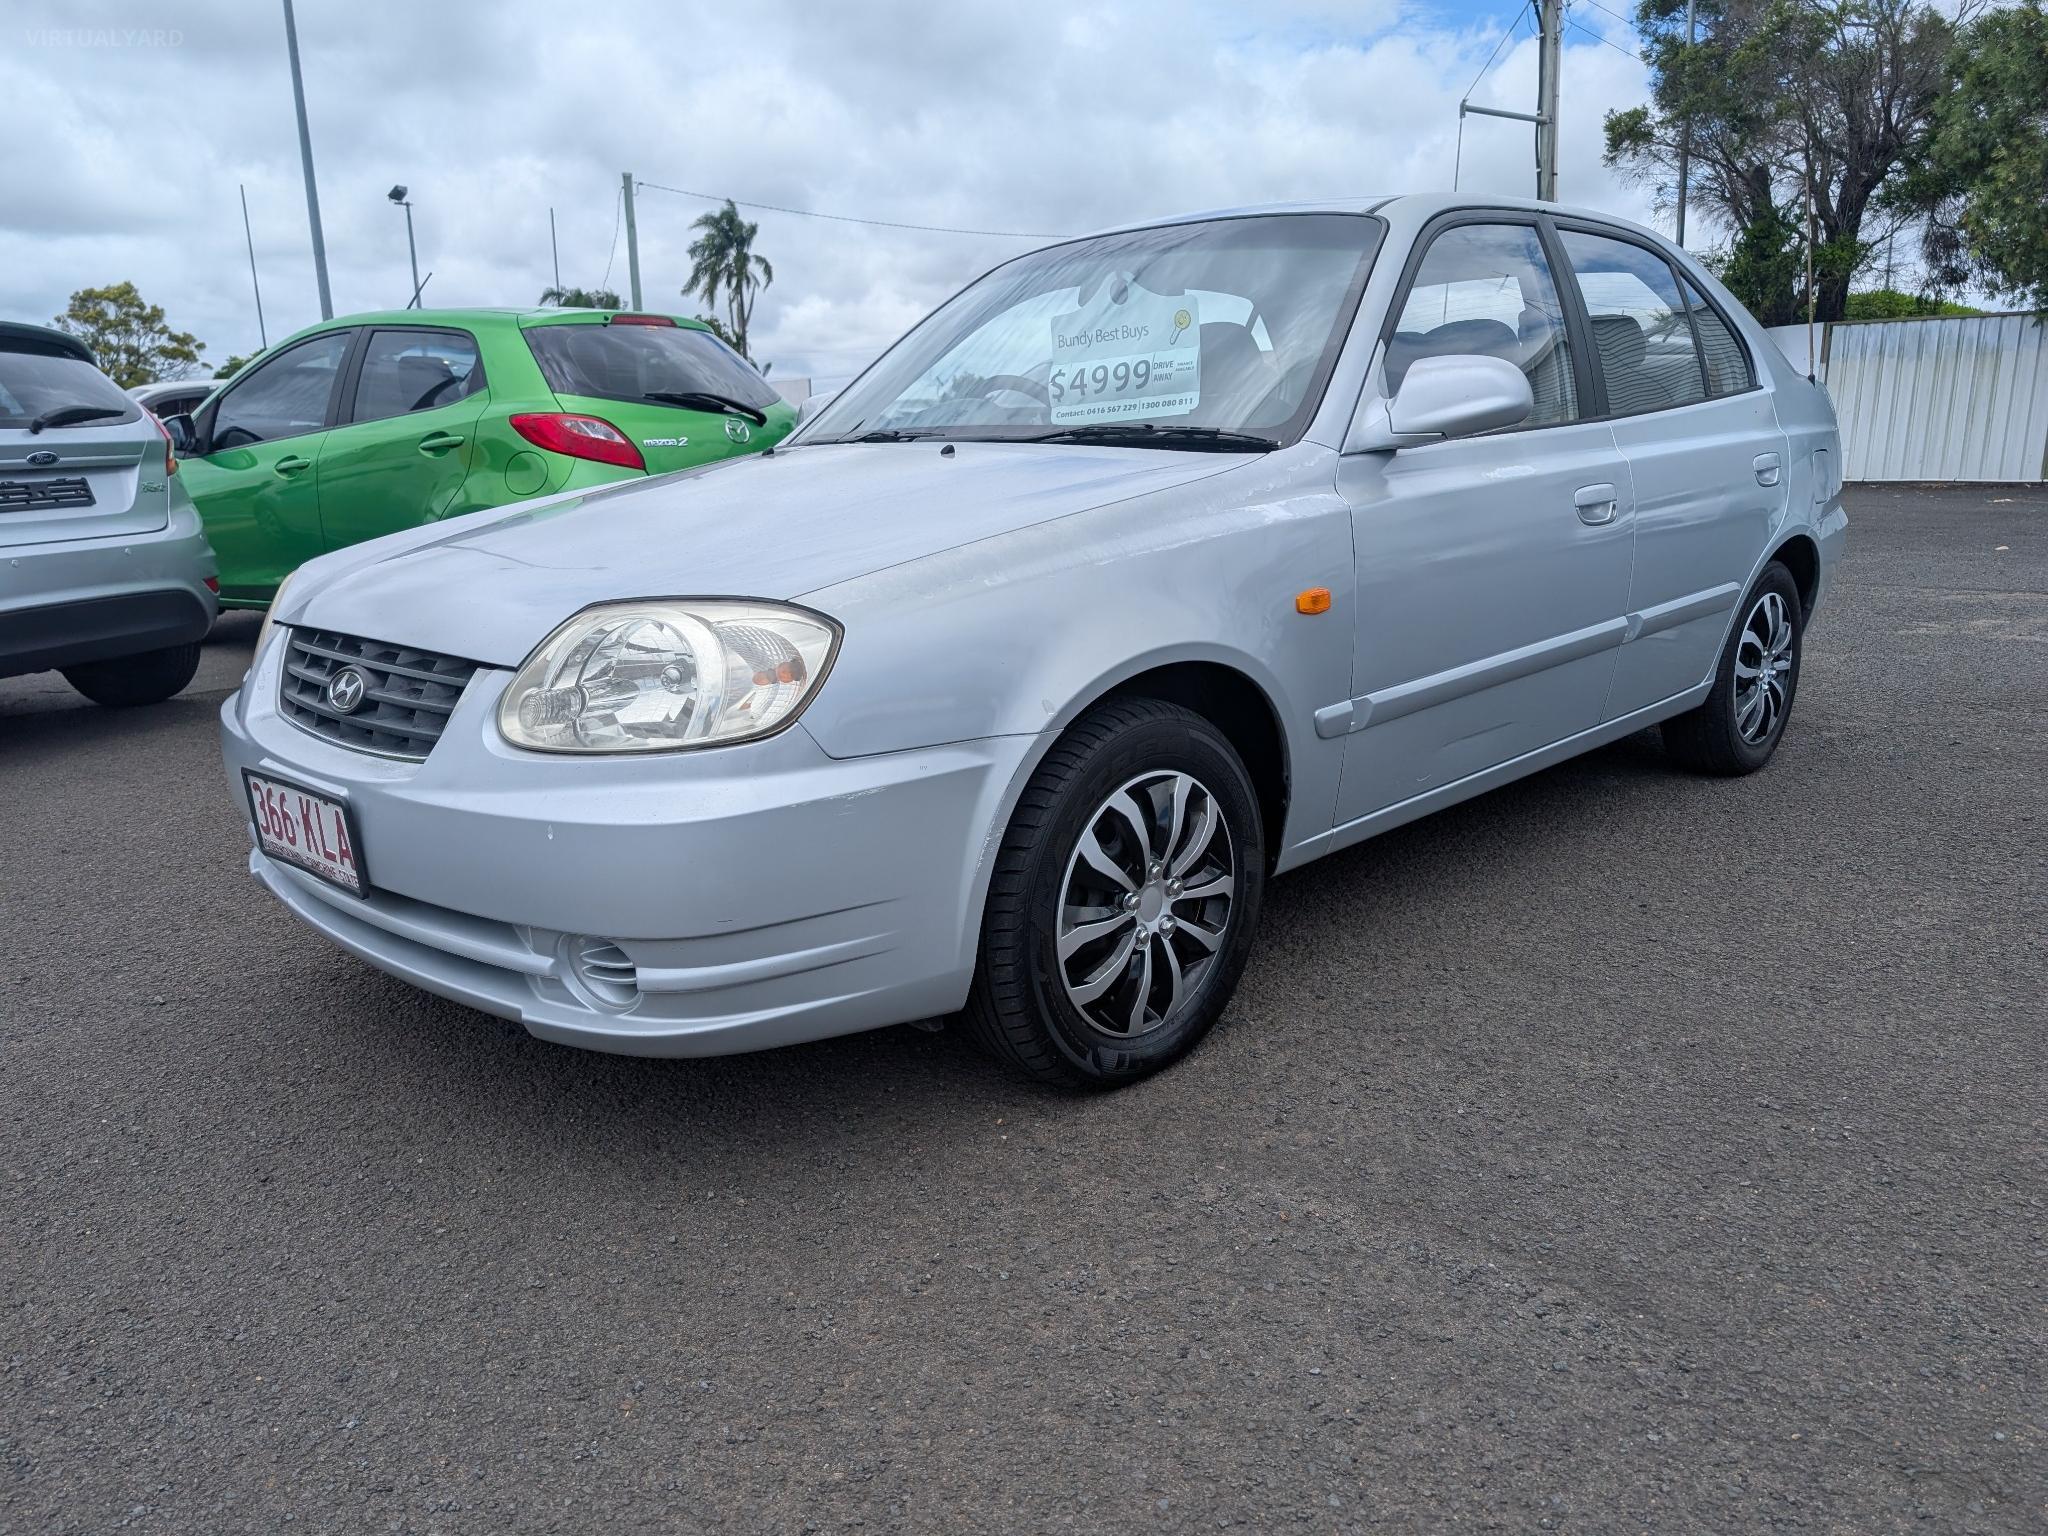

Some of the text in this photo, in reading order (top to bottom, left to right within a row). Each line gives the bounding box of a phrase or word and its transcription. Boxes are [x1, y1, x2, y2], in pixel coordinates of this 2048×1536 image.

[1058, 324, 1150, 348] Bundy Best Buys
[1153, 360, 1174, 370] DRIVE
[1049, 359, 1151, 402] $4999
[1153, 372, 1173, 382] AWAY
[1056, 409, 1086, 418] Contact:
[1086, 406, 1106, 415] 0416
[1107, 404, 1121, 413] 567
[1123, 402, 1137, 411] 229
[1141, 401, 1160, 410] 1300
[1178, 397, 1193, 406] 811
[252, 781, 297, 846] 366
[298, 796, 357, 871] KLA
